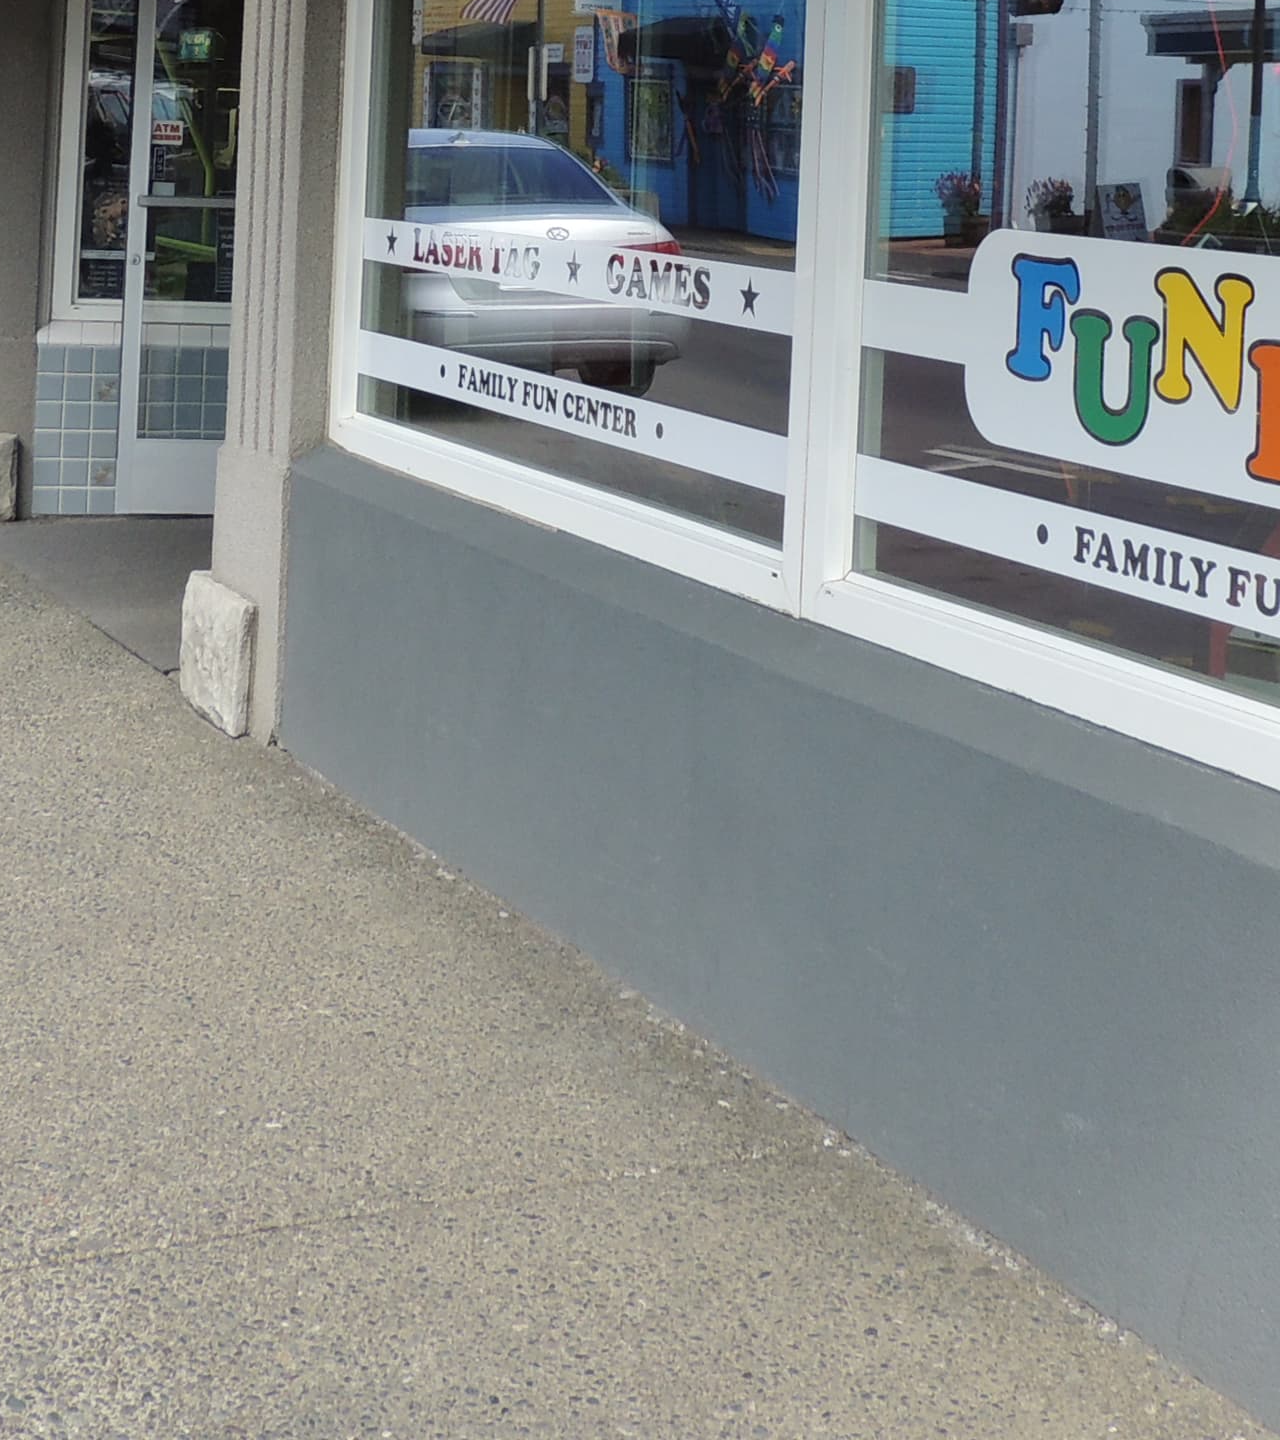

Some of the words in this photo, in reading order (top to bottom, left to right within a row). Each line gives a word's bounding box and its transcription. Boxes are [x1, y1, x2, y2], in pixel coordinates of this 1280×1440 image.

[154, 123, 180, 133] ATM
[412, 227, 483, 272] LASER
[490, 239, 540, 281] TAG
[606, 254, 711, 310] GAMES
[457, 364, 519, 402] FAMILY
[522, 382, 558, 412] FUN
[563, 393, 638, 438] CENTER
[1073, 523, 1218, 597] FAMILY
